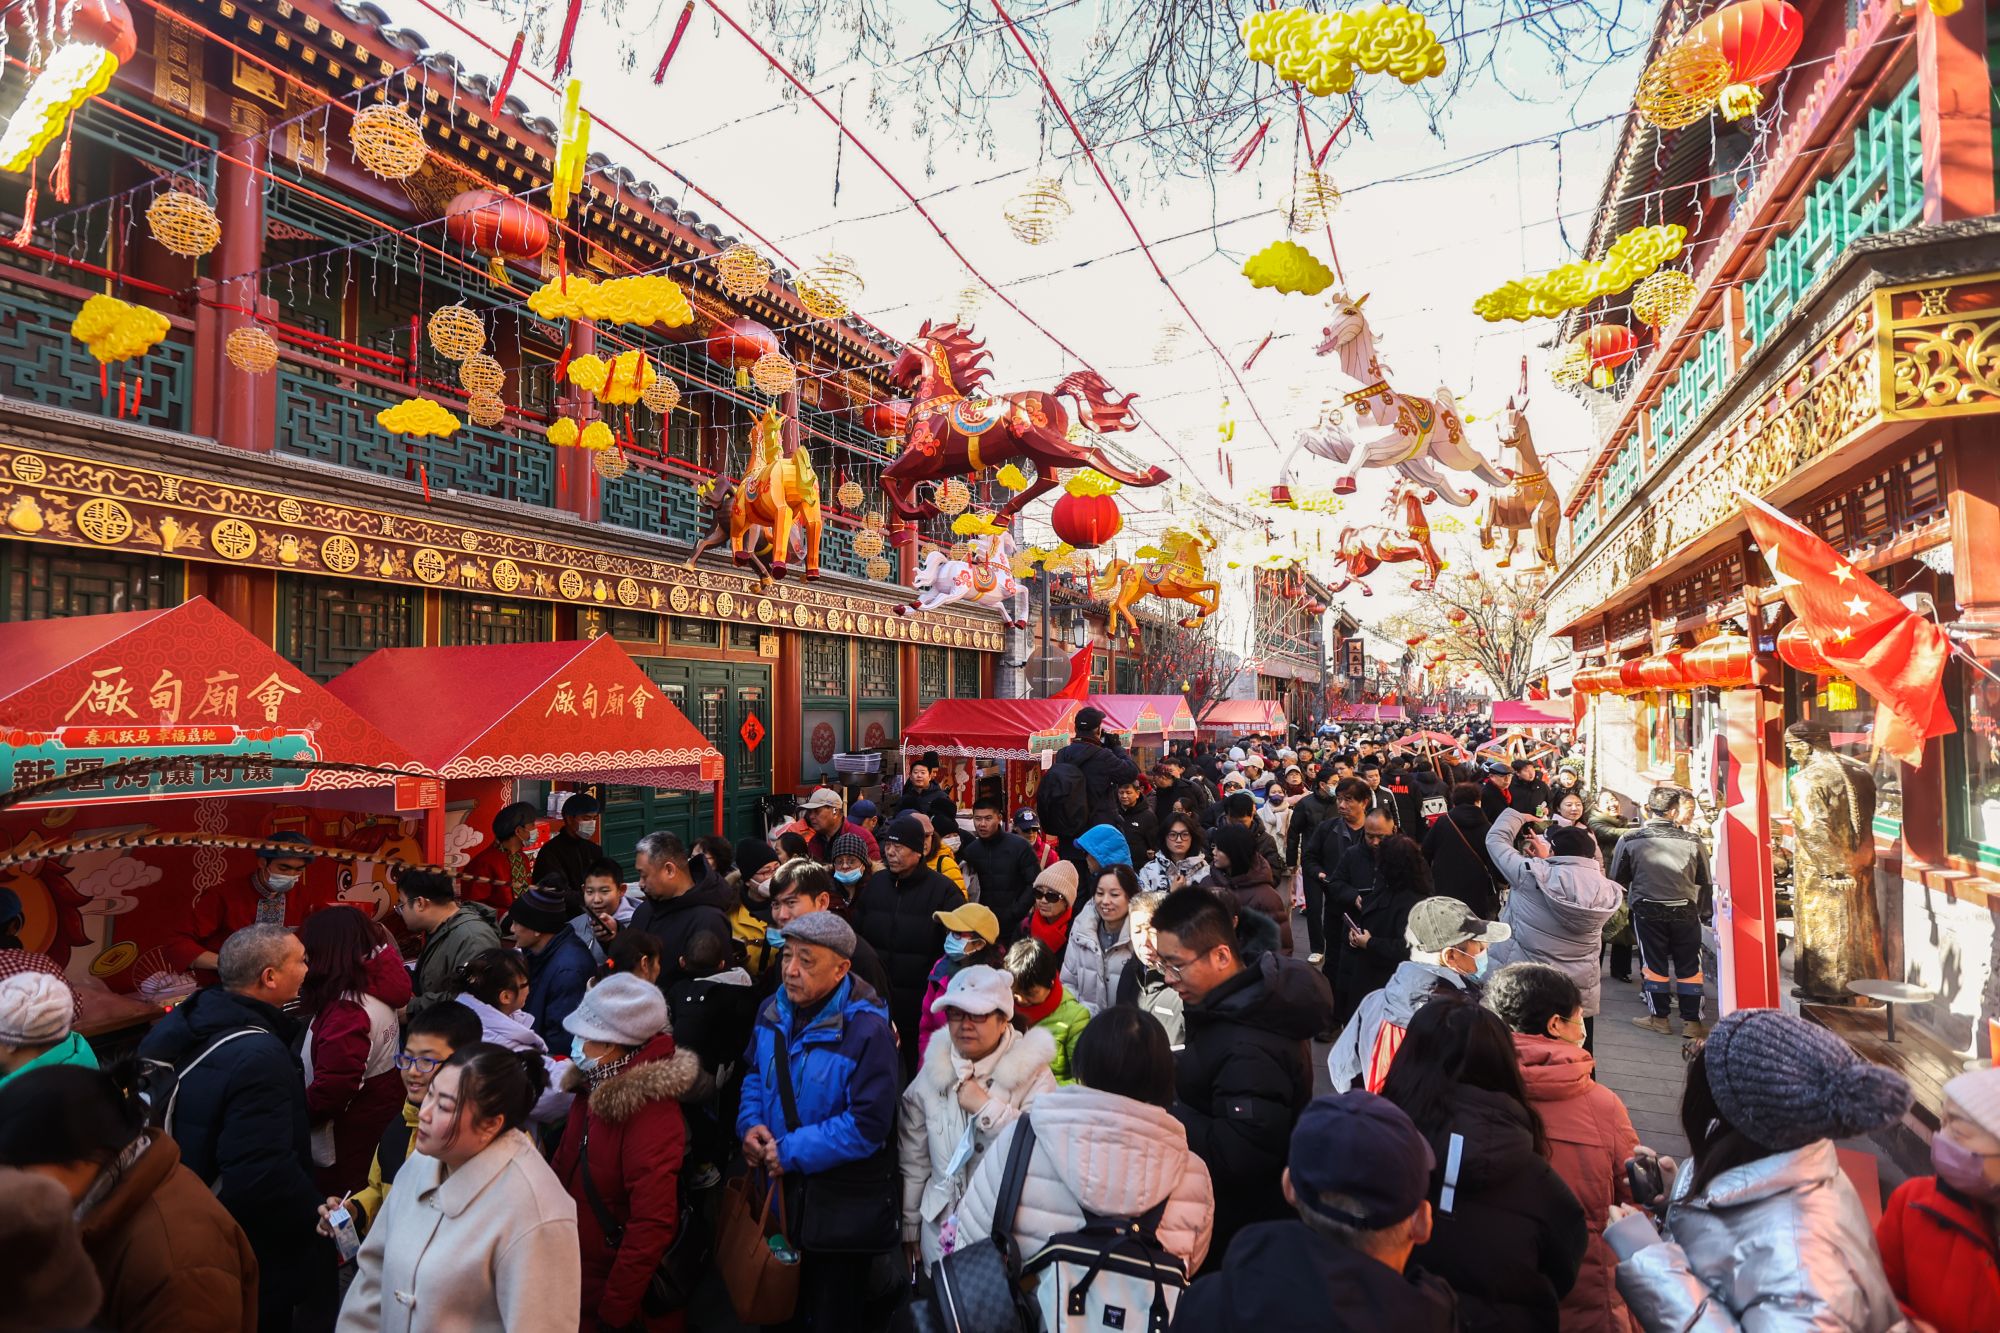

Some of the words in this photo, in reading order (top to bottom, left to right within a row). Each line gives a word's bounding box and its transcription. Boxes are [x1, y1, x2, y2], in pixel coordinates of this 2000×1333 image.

[765, 645, 774, 655] 80
[84, 728, 150, 745] 春风跃马
